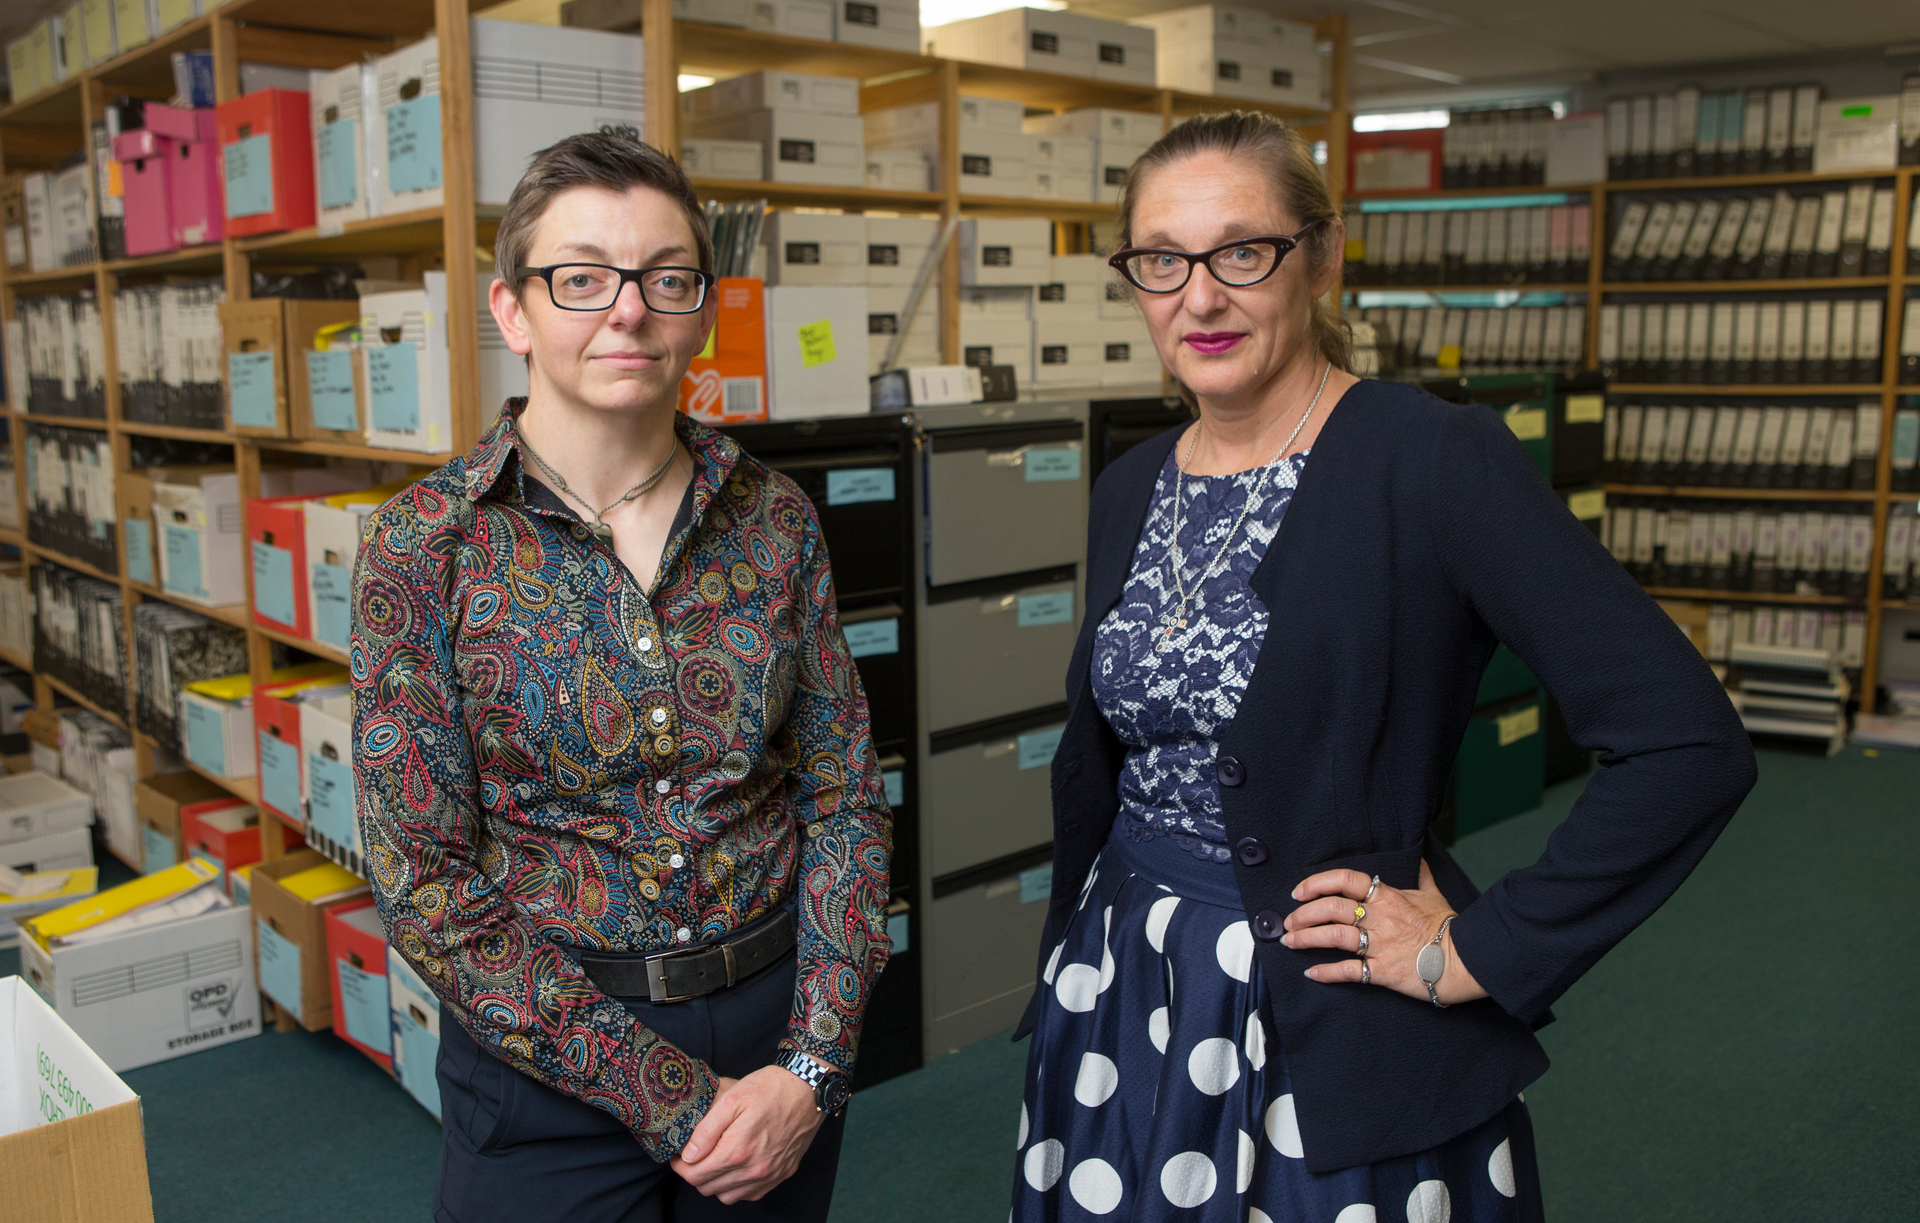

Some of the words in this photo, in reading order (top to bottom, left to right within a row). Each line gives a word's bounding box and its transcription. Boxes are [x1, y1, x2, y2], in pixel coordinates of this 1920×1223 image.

[190, 983, 228, 1003] OPD
[168, 1027, 225, 1050] STORAGE
[229, 1018, 255, 1034] BOX
[37, 1042, 55, 1091] 769)
[57, 1069, 75, 1109] 493
